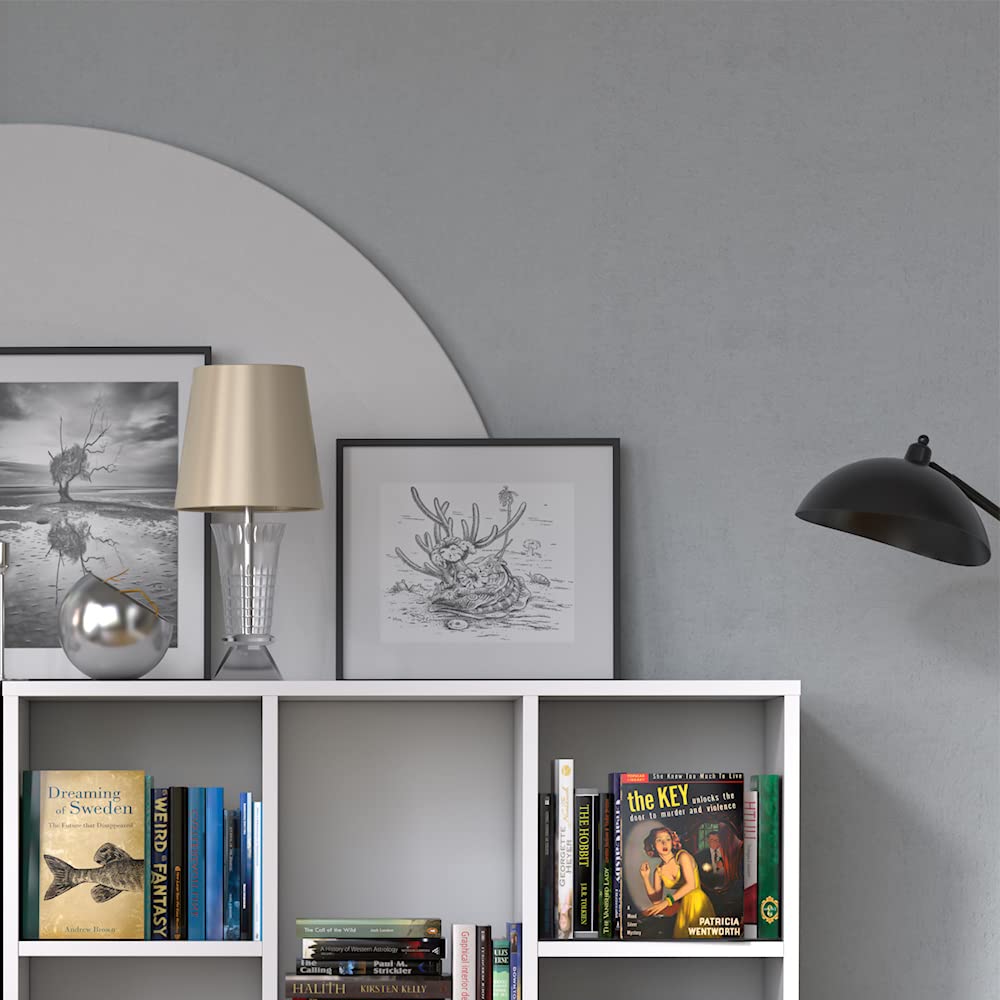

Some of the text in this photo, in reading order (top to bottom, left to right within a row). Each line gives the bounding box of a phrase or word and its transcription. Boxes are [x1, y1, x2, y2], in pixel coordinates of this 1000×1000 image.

[48, 786, 121, 802] Dreaming
[628, 790, 655, 812] the
[658, 784, 689, 808] KEY
[692, 794, 719, 804] unlocks
[56, 801, 134, 815] of Sweden
[630, 814, 645, 822] door
[661, 809, 686, 818] murder
[689, 806, 702, 814] and
[707, 803, 736, 812] violence
[97, 822, 134, 830] Disappeared
[579, 804, 590, 867] THE HOBBIT
[153, 796, 168, 938] WEIRD FANTASY
[580, 898, 588, 925] TOLKIEN
[699, 918, 740, 926] PATRICIA
[688, 927, 740, 936] WENTWORTH
[325, 946, 344, 954] History
[374, 946, 398, 954] Astrology
[460, 931, 470, 964] Graphical
[300, 967, 332, 975] Calling
[461, 965, 469, 990] interior
[360, 985, 427, 993] KIRSTEN KELLY
